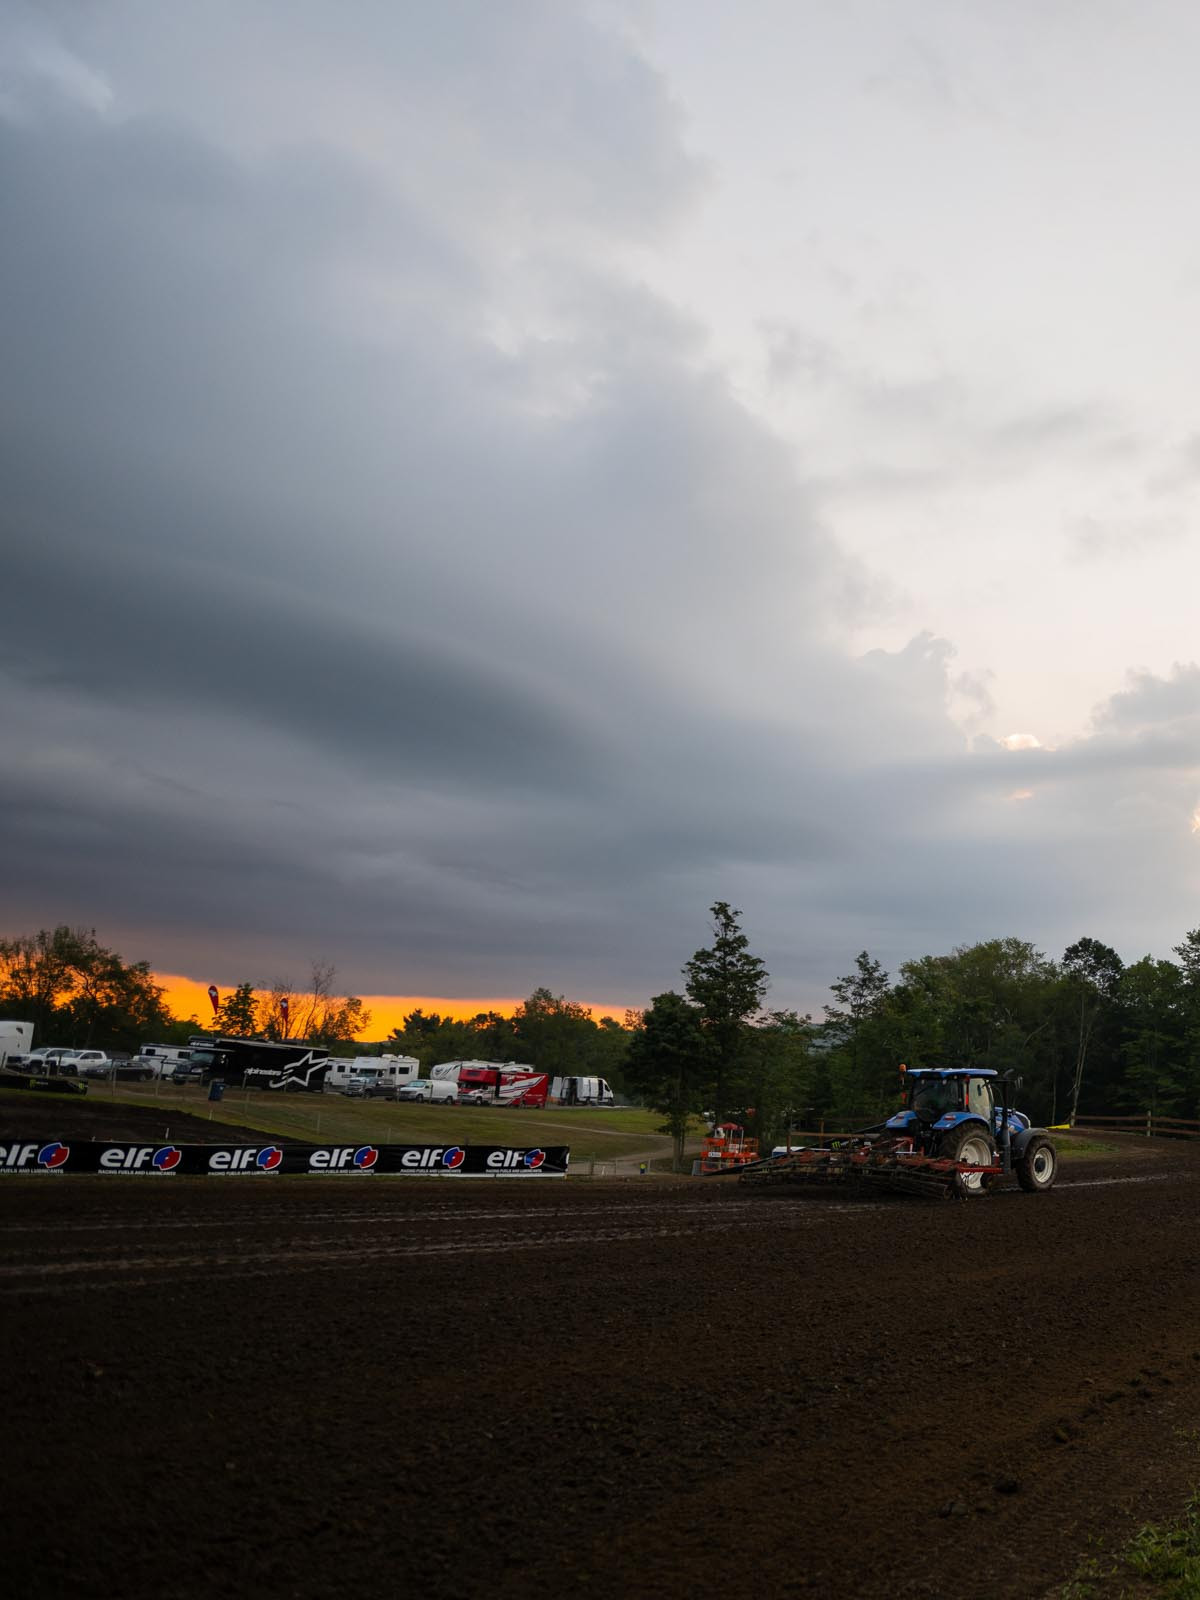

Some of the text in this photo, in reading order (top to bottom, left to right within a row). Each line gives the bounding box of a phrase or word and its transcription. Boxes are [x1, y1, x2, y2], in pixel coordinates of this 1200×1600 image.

[99, 1147, 154, 1168] elf
[208, 1149, 257, 1169] elf
[308, 1148, 355, 1168] elf
[401, 1148, 443, 1167] elf
[486, 1149, 525, 1167] elf
